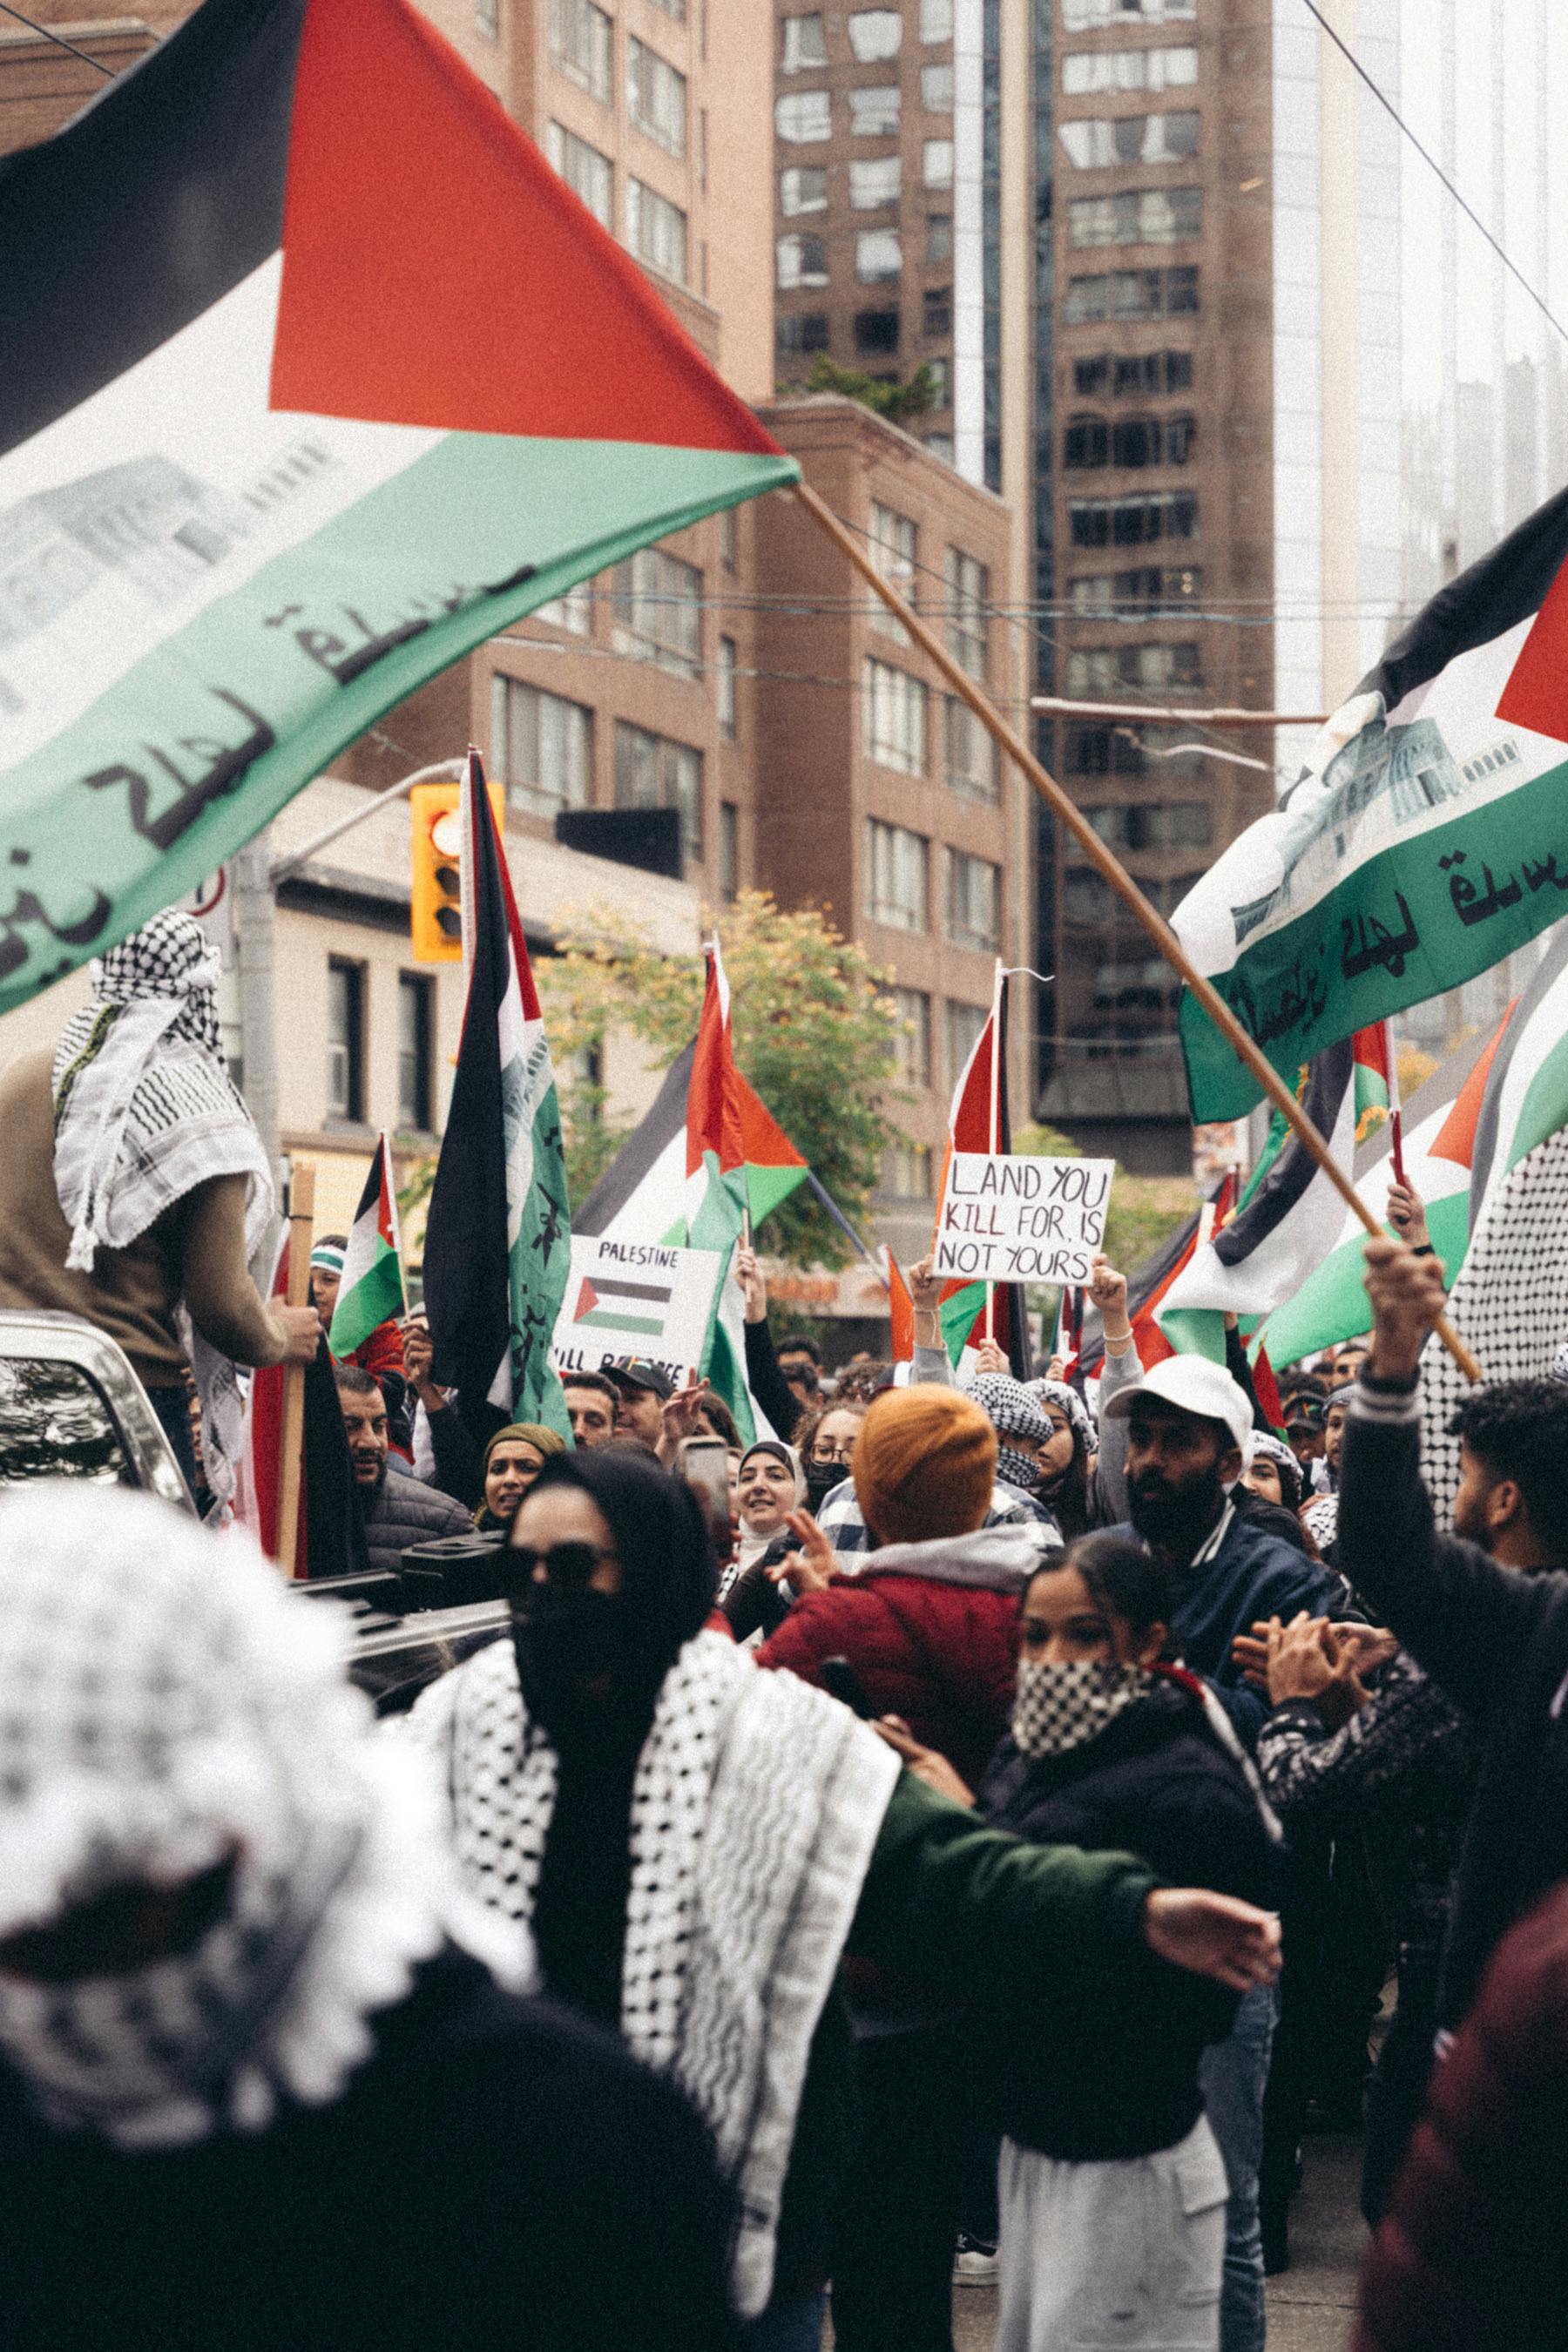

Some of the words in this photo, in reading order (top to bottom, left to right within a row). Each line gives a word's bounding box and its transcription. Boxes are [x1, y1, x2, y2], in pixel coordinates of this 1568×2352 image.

[951, 1159, 1041, 1200] LAND
[1048, 1164, 1108, 1209] YOU
[945, 1202, 1005, 1236] KILL
[1017, 1205, 1072, 1243] FOR,
[1080, 1210, 1103, 1247] IS
[598, 1241, 679, 1268] PALESTINE
[938, 1242, 997, 1274] NOT
[1006, 1247, 1089, 1281] YOURS
[554, 1347, 585, 1371] ILL
